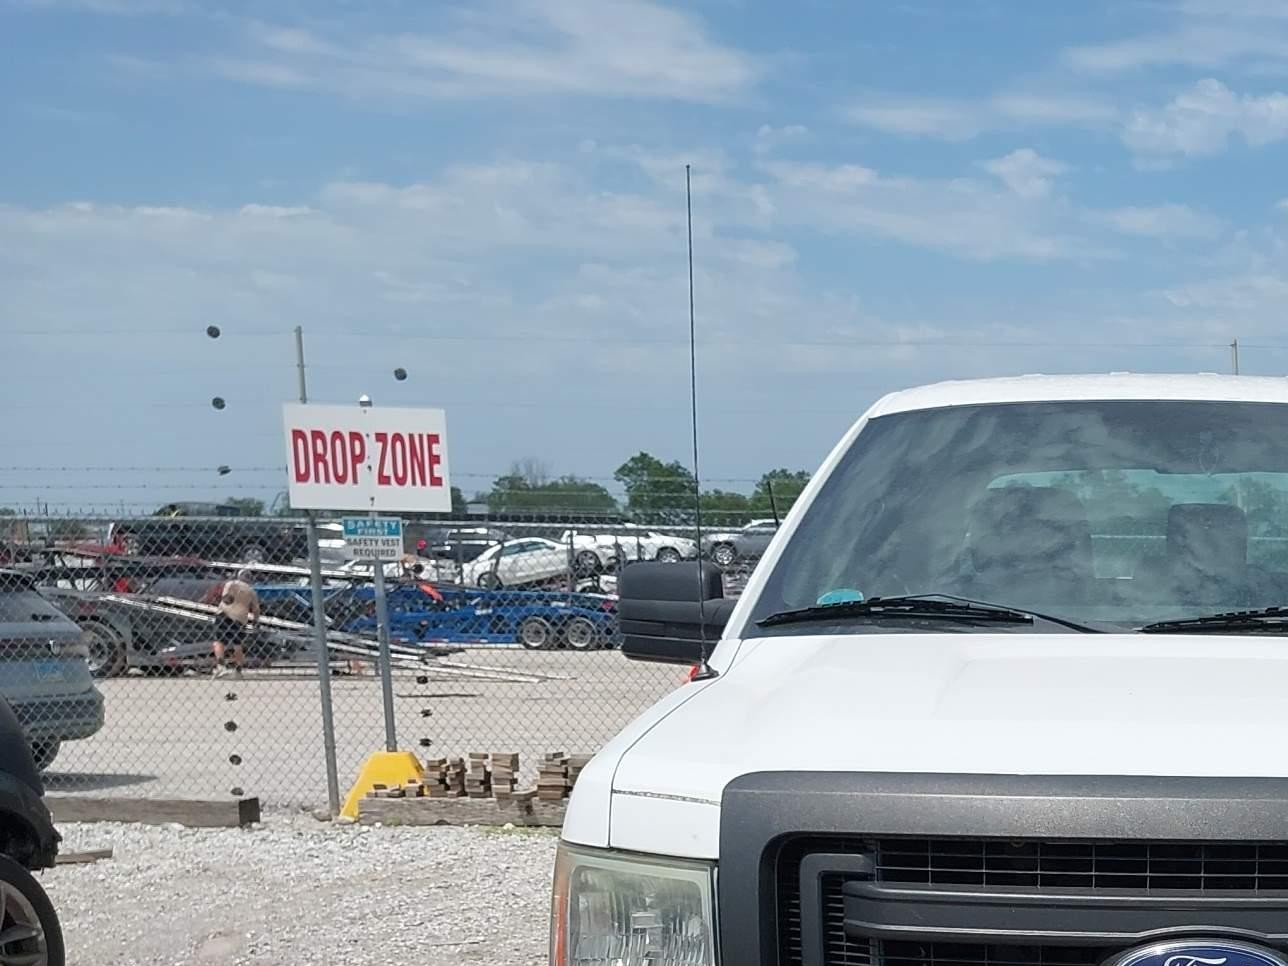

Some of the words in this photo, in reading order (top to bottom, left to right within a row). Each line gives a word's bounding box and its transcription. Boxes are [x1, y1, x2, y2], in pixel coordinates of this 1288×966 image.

[291, 428, 366, 485] DROP
[375, 431, 443, 487] ZONE
[347, 520, 397, 530] SAFETY
[357, 527, 389, 536] FIRST
[346, 538, 379, 548] SAFETY
[381, 538, 401, 548] VEST
[353, 548, 397, 558] REQUIRED
